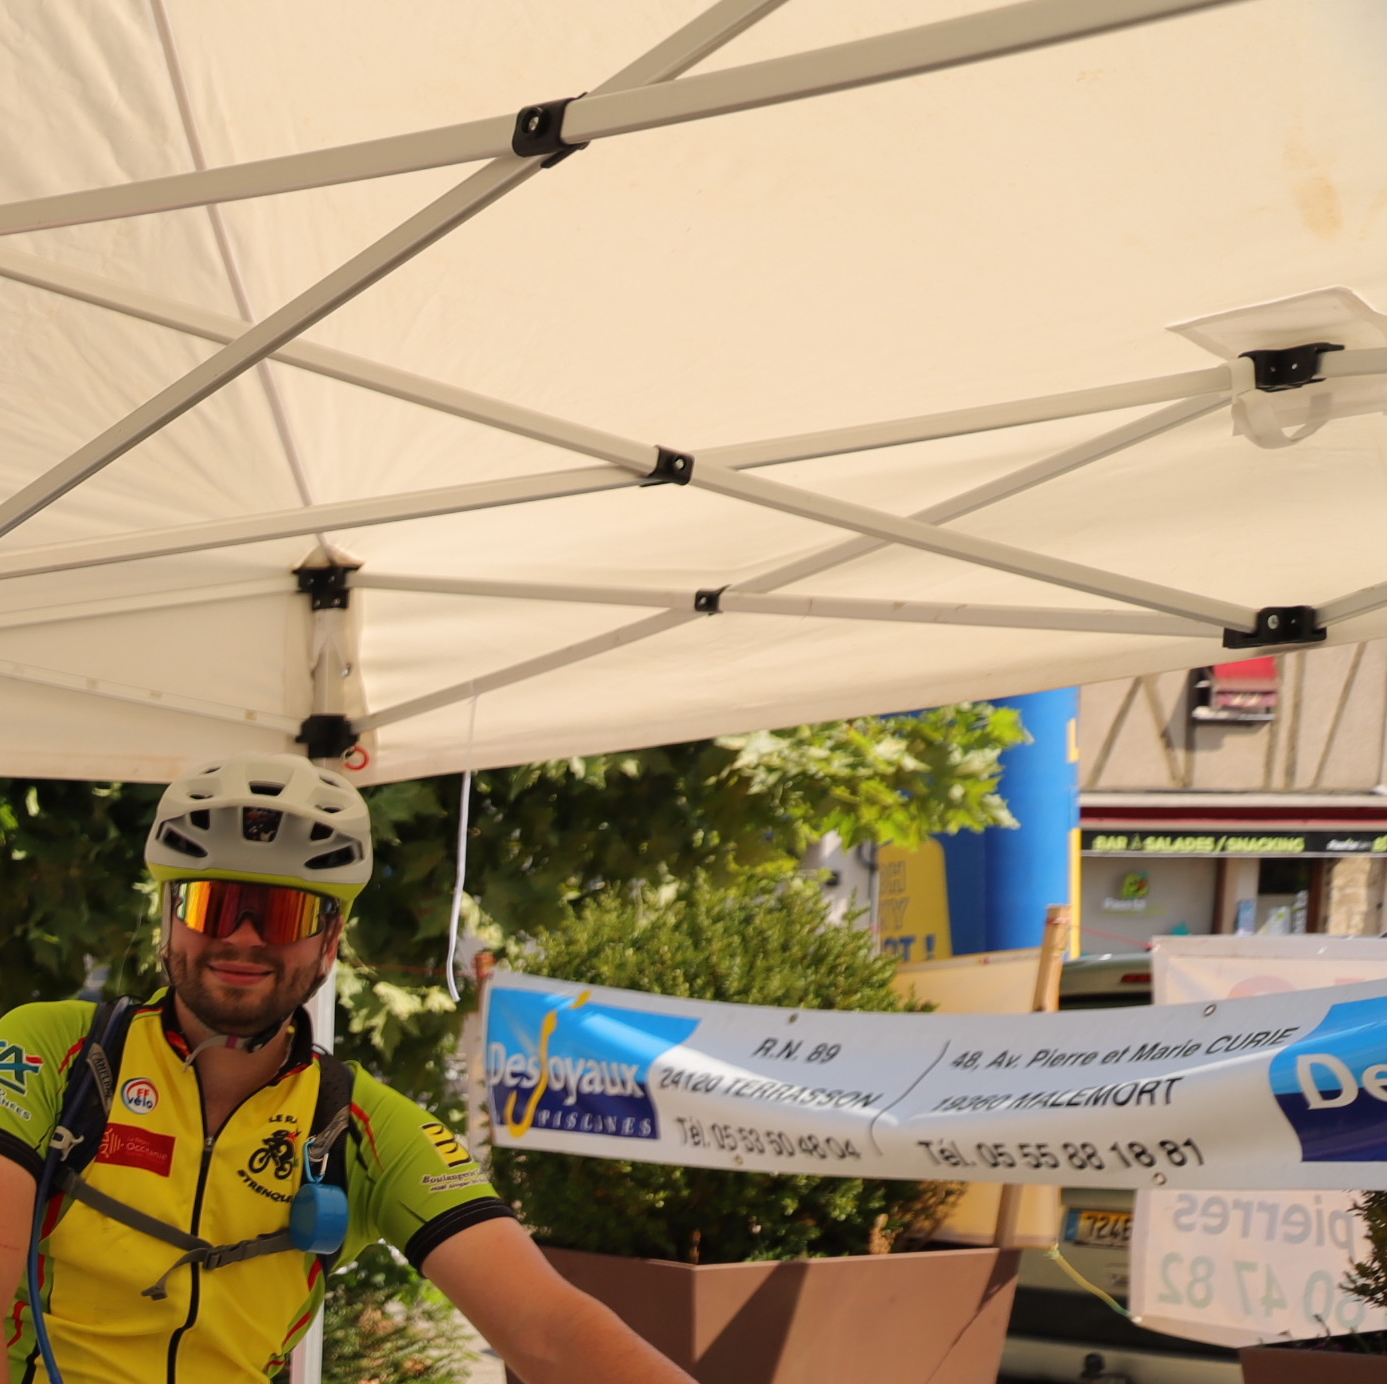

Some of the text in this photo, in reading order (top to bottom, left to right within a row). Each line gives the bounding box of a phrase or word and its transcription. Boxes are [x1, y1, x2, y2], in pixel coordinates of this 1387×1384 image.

[753, 1037, 842, 1065] R.N. 89
[987, 1050, 1019, 1070] Av.
[1025, 1047, 1099, 1069] Pierre
[1100, 1047, 1130, 1066] et
[1129, 1040, 1200, 1063] Marie
[1205, 1025, 1302, 1055] CURIE
[127, 1095, 153, 1110] vélo
[136, 1087, 151, 1097] FF
[726, 1076, 884, 1109] TERRASSON
[1003, 1075, 1185, 1111] MALEMORT
[676, 1116, 713, 1149] Tél.
[917, 1137, 973, 1169] Tél.
[975, 1140, 1017, 1170] 05
[1019, 1140, 1060, 1171] 55
